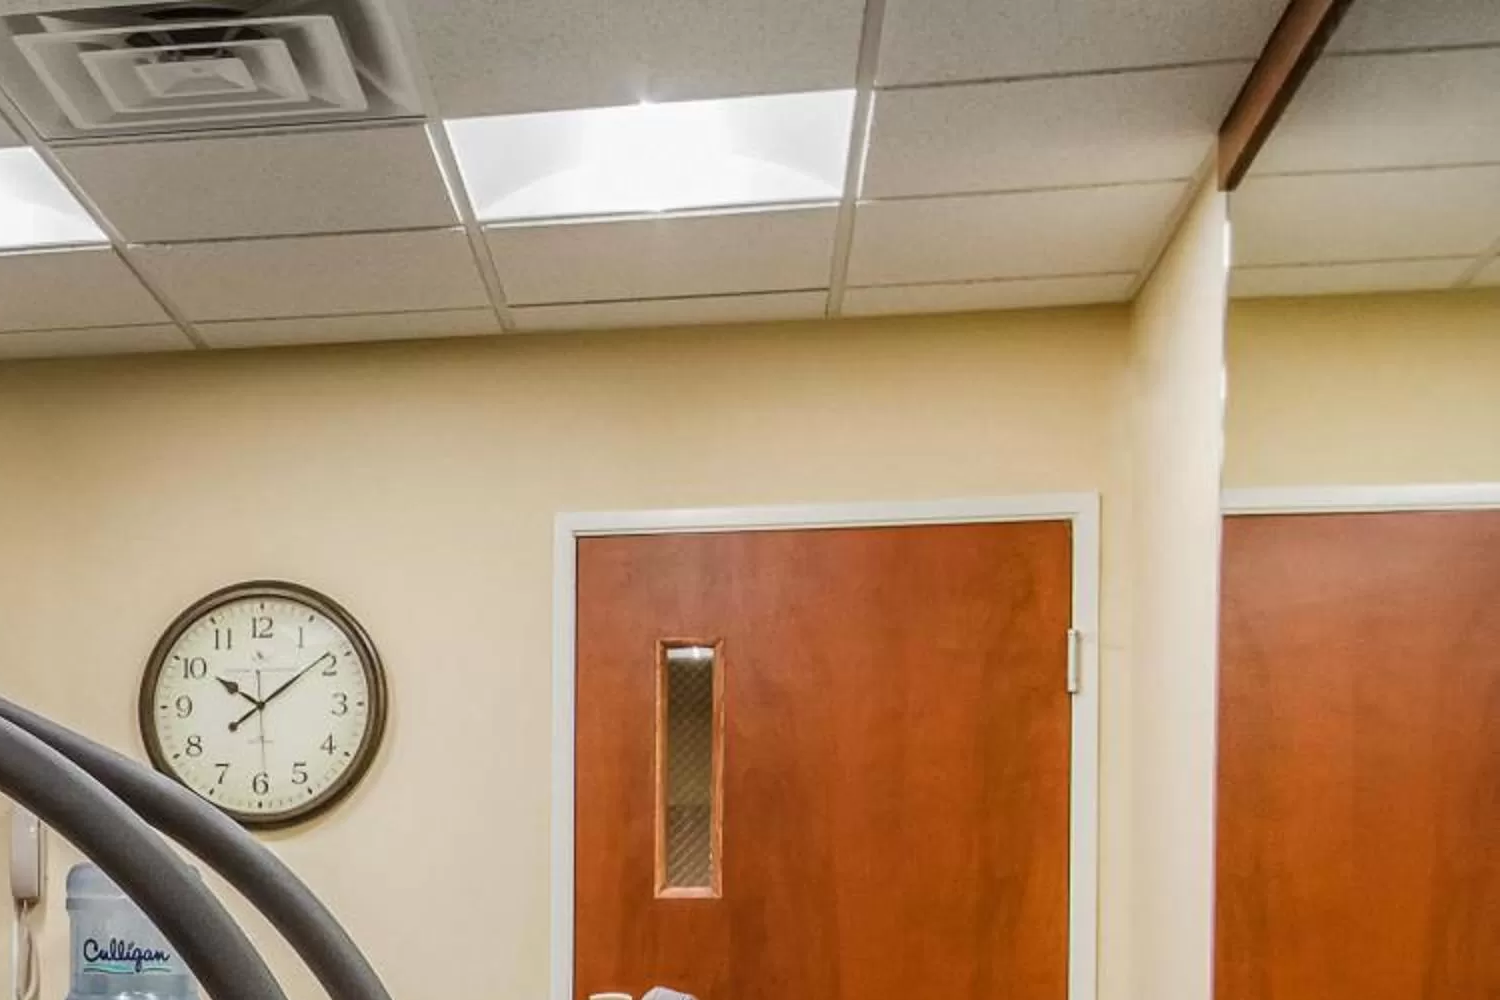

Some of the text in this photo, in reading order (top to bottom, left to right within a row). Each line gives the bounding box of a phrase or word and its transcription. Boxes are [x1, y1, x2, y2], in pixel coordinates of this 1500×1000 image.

[214, 628, 233, 650] 11
[251, 616, 274, 639] 12
[182, 657, 207, 679] 10
[321, 653, 338, 677] 2
[175, 695, 193, 718] 9
[331, 693, 349, 716] 3
[185, 735, 203, 757] 8
[320, 734, 337, 755] 4
[214, 763, 231, 784] 7
[252, 772, 270, 796] 6
[291, 762, 308, 785] 5
[83, 937, 171, 973] Culligan
